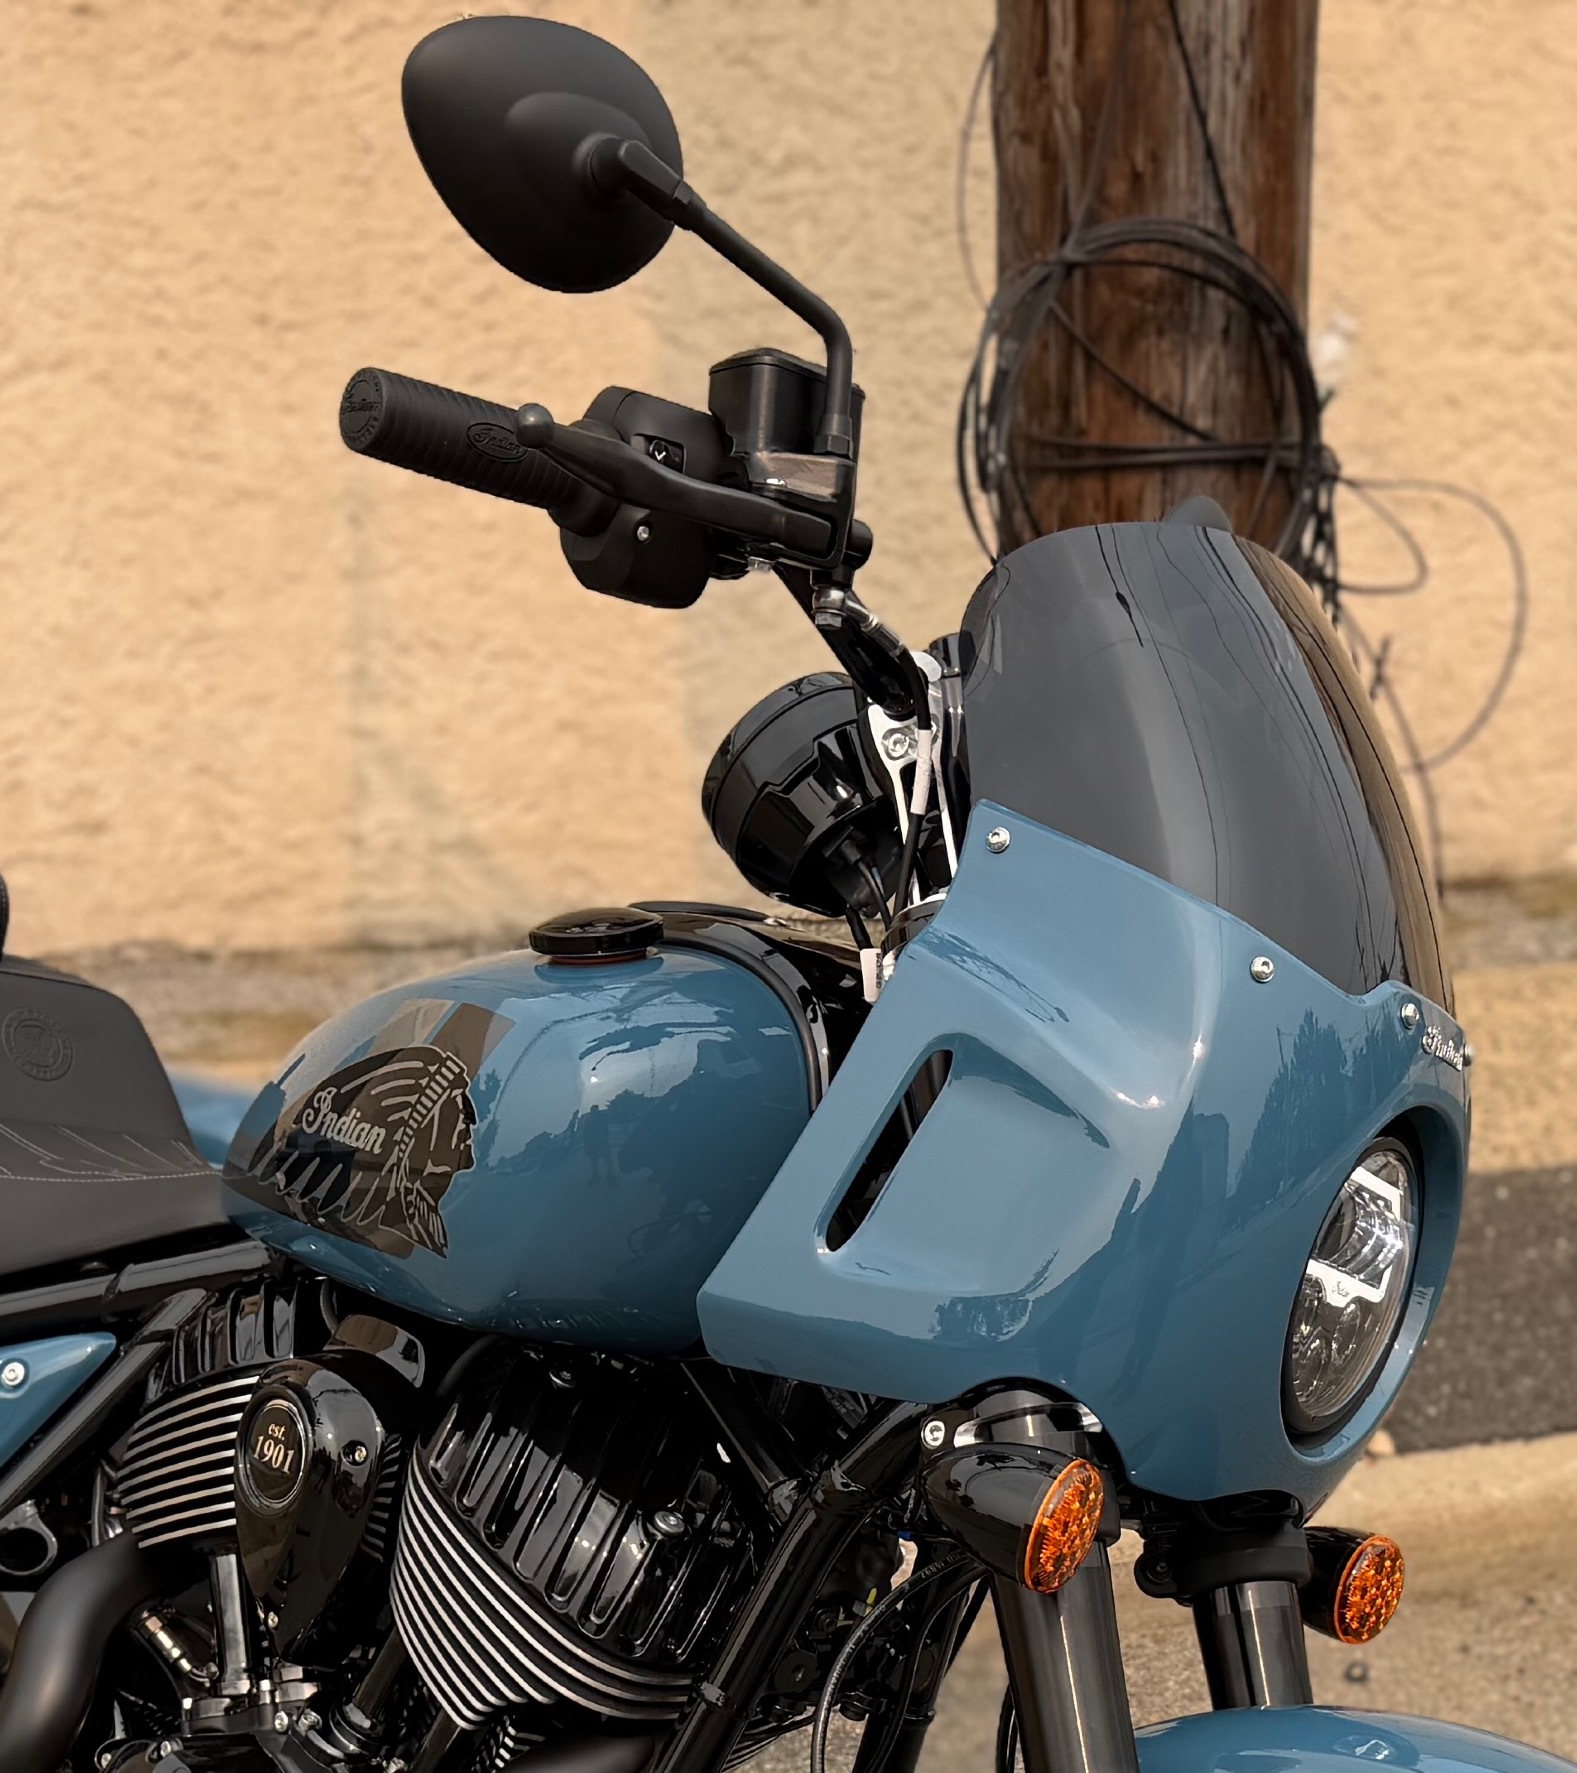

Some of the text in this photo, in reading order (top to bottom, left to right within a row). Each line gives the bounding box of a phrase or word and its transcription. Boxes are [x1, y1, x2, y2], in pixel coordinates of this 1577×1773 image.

[302, 1087, 386, 1154] Indian
[268, 1423, 286, 1440] est.
[254, 1435, 294, 1474] 1901
